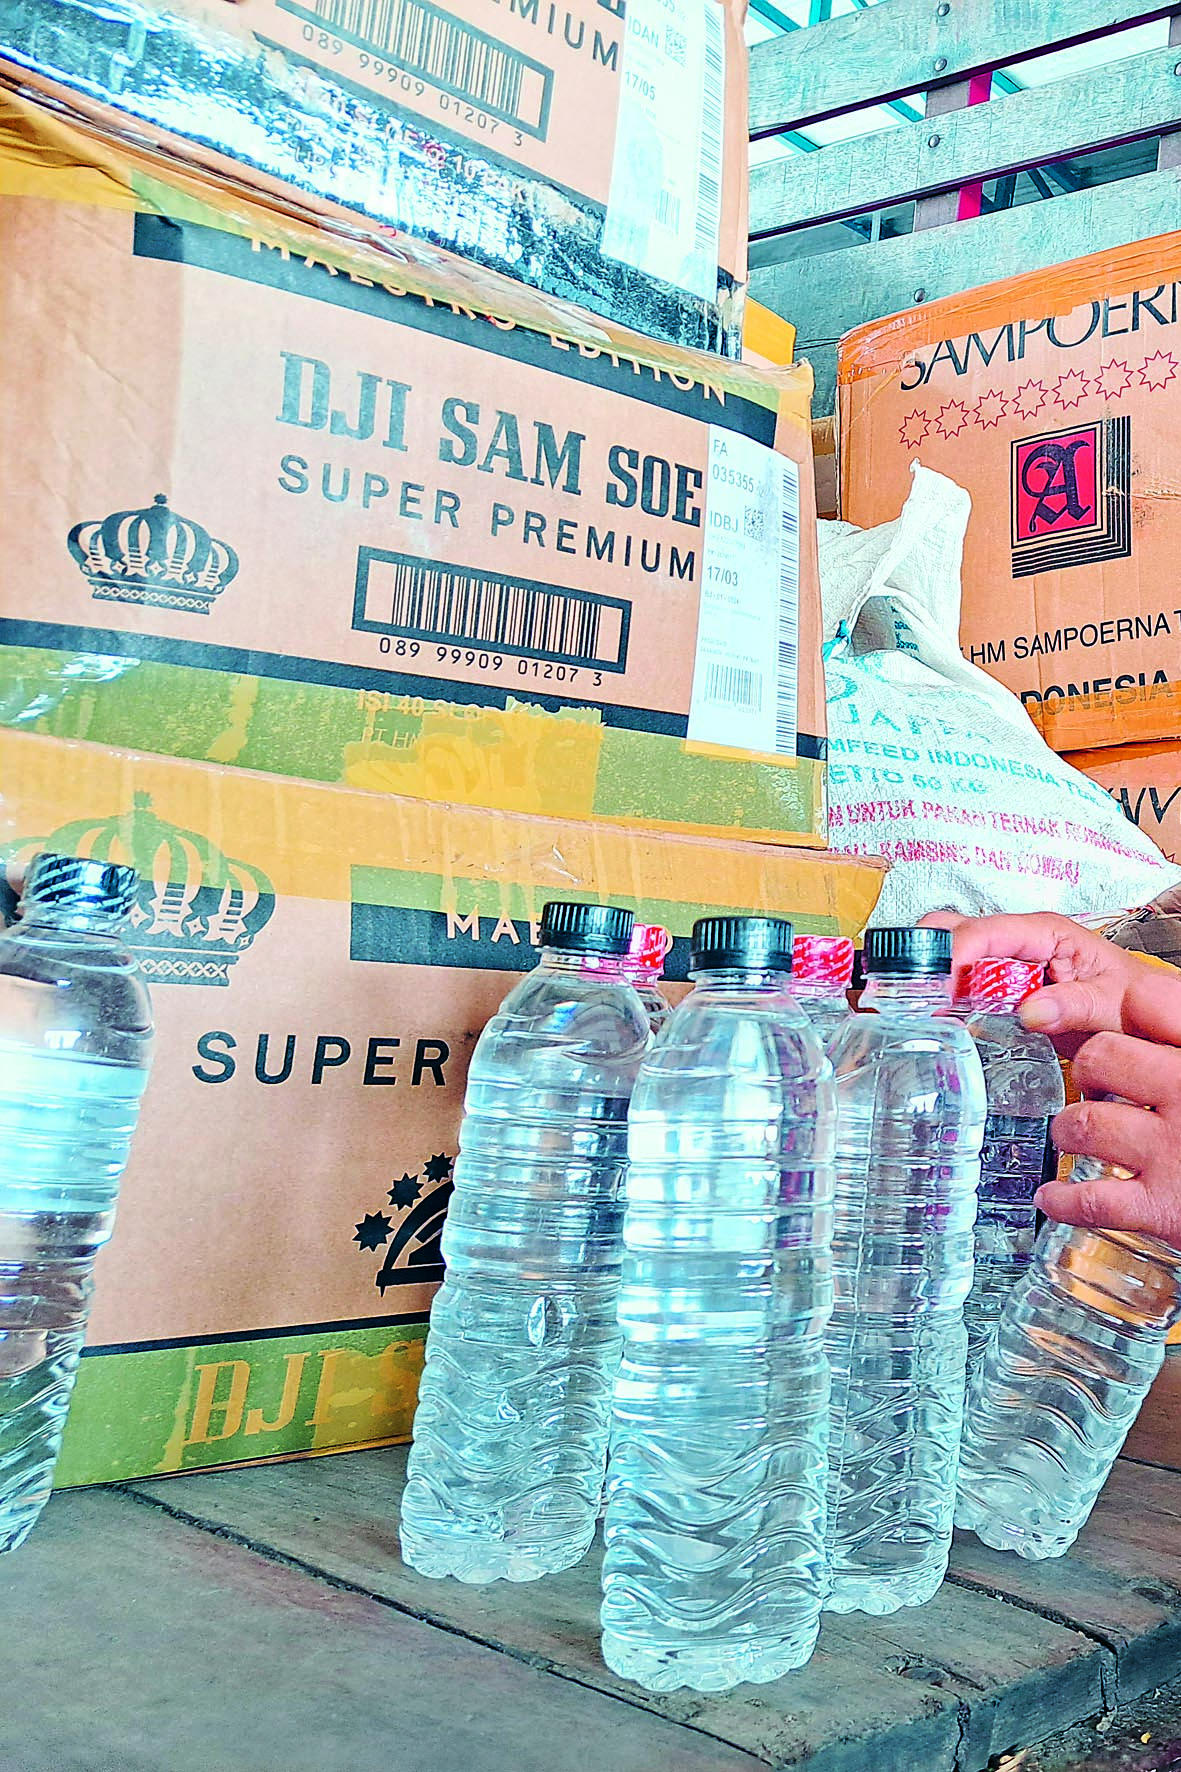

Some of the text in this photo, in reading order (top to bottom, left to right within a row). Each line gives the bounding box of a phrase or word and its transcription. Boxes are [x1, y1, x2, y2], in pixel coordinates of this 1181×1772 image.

[303, 24, 344, 56] 089
[359, 52, 426, 97] 99909
[439, 94, 500, 133] 01207
[513, 131, 523, 147] 3
[625, 70, 656, 100] 17/05
[276, 351, 703, 528] DJI SAM SOE
[713, 439, 729, 456] FA
[277, 454, 696, 582] SUPER PREMIUM
[707, 565, 738, 587] 17/03
[379, 637, 602, 687] 089 99909 01207 3
[970, 640, 1006, 665] HM
[1013, 613, 1171, 660] SAMPOERNA
[1018, 669, 1174, 718] DONESIA
[827, 737, 920, 762] MFEED
[928, 749, 1061, 789] INDONESIA
[829, 763, 905, 785] ETTO
[191, 1031, 451, 1088] SUPER
